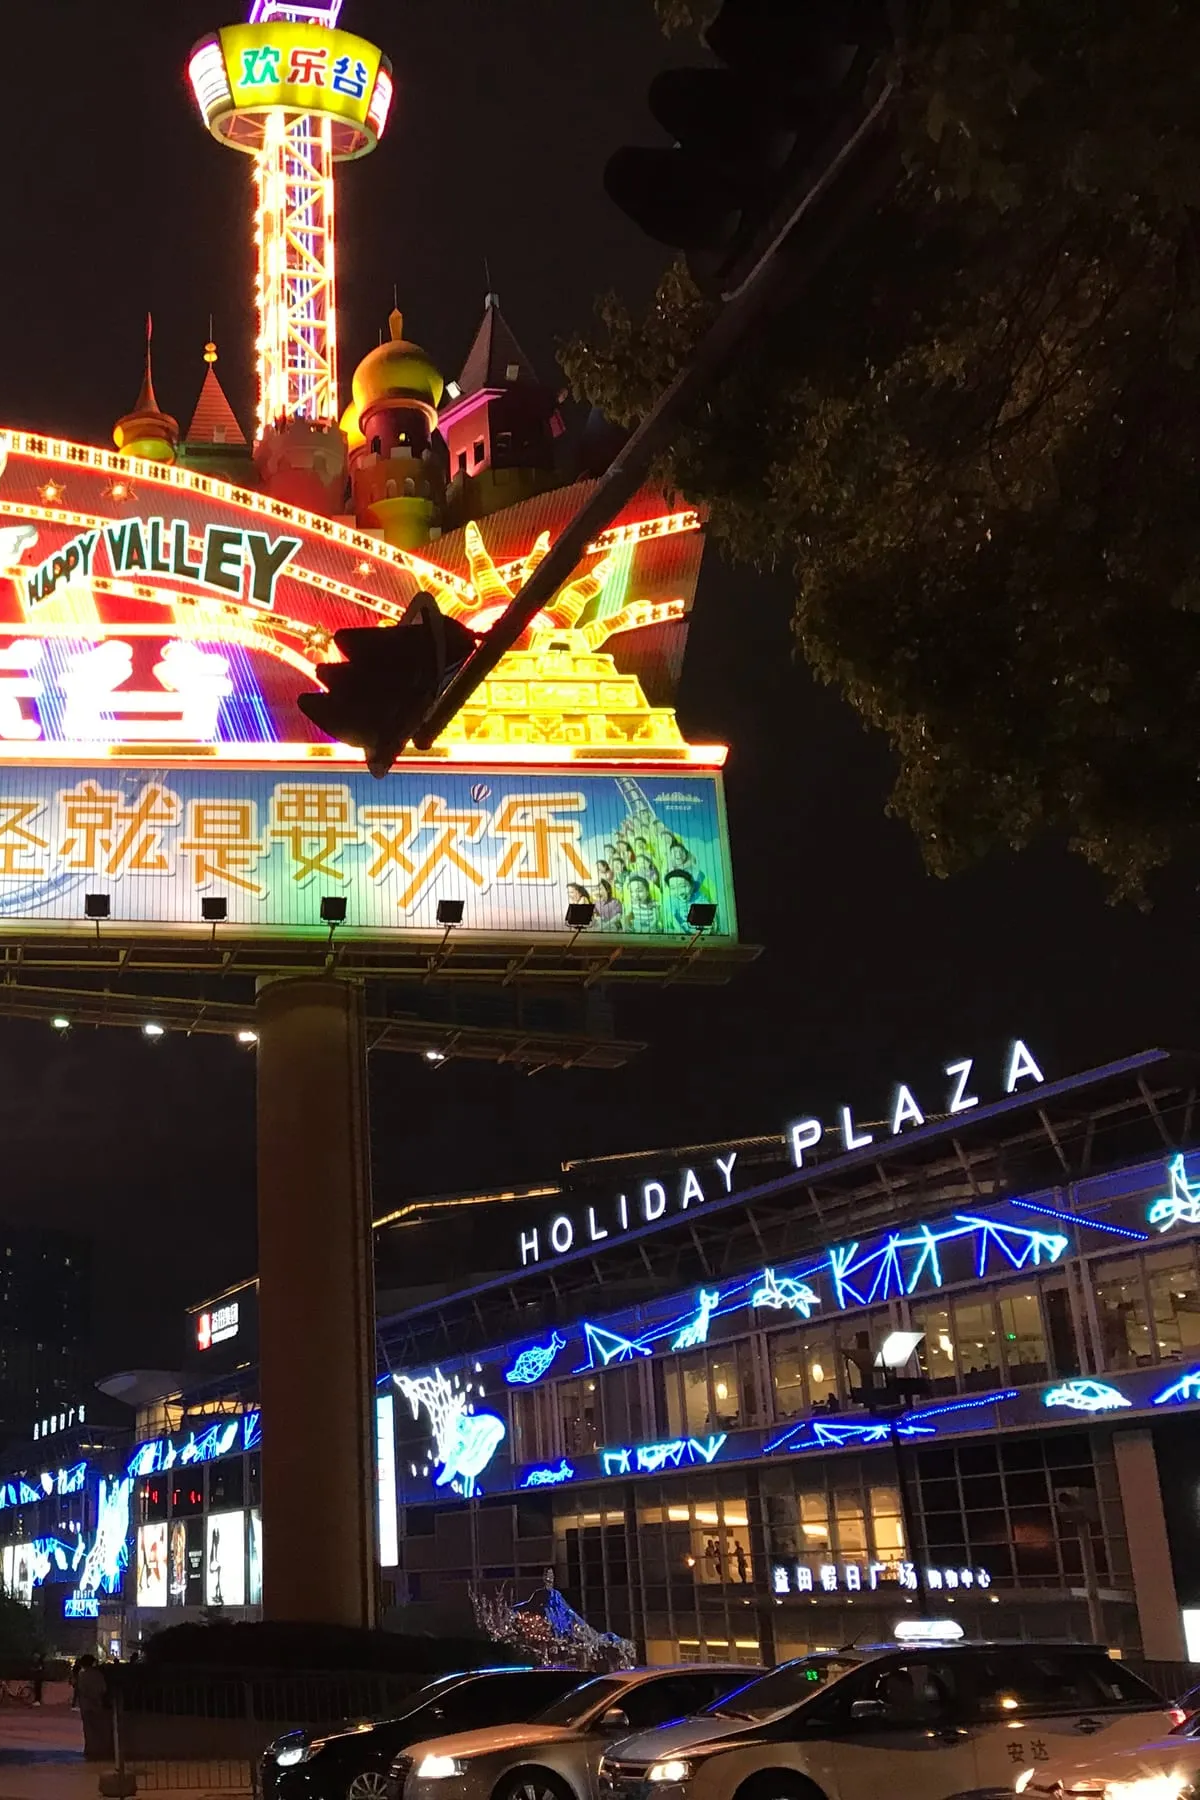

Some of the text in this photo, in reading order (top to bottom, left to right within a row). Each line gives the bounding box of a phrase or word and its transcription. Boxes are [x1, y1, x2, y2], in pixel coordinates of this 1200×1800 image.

[27, 521, 298, 607] HAPPY VALLEY
[519, 1039, 1045, 1266] HOLIDAY PLAZA
[774, 1562, 991, 1594] 益田假日广场 购物中心
[1006, 1739, 1050, 1764] 安达
